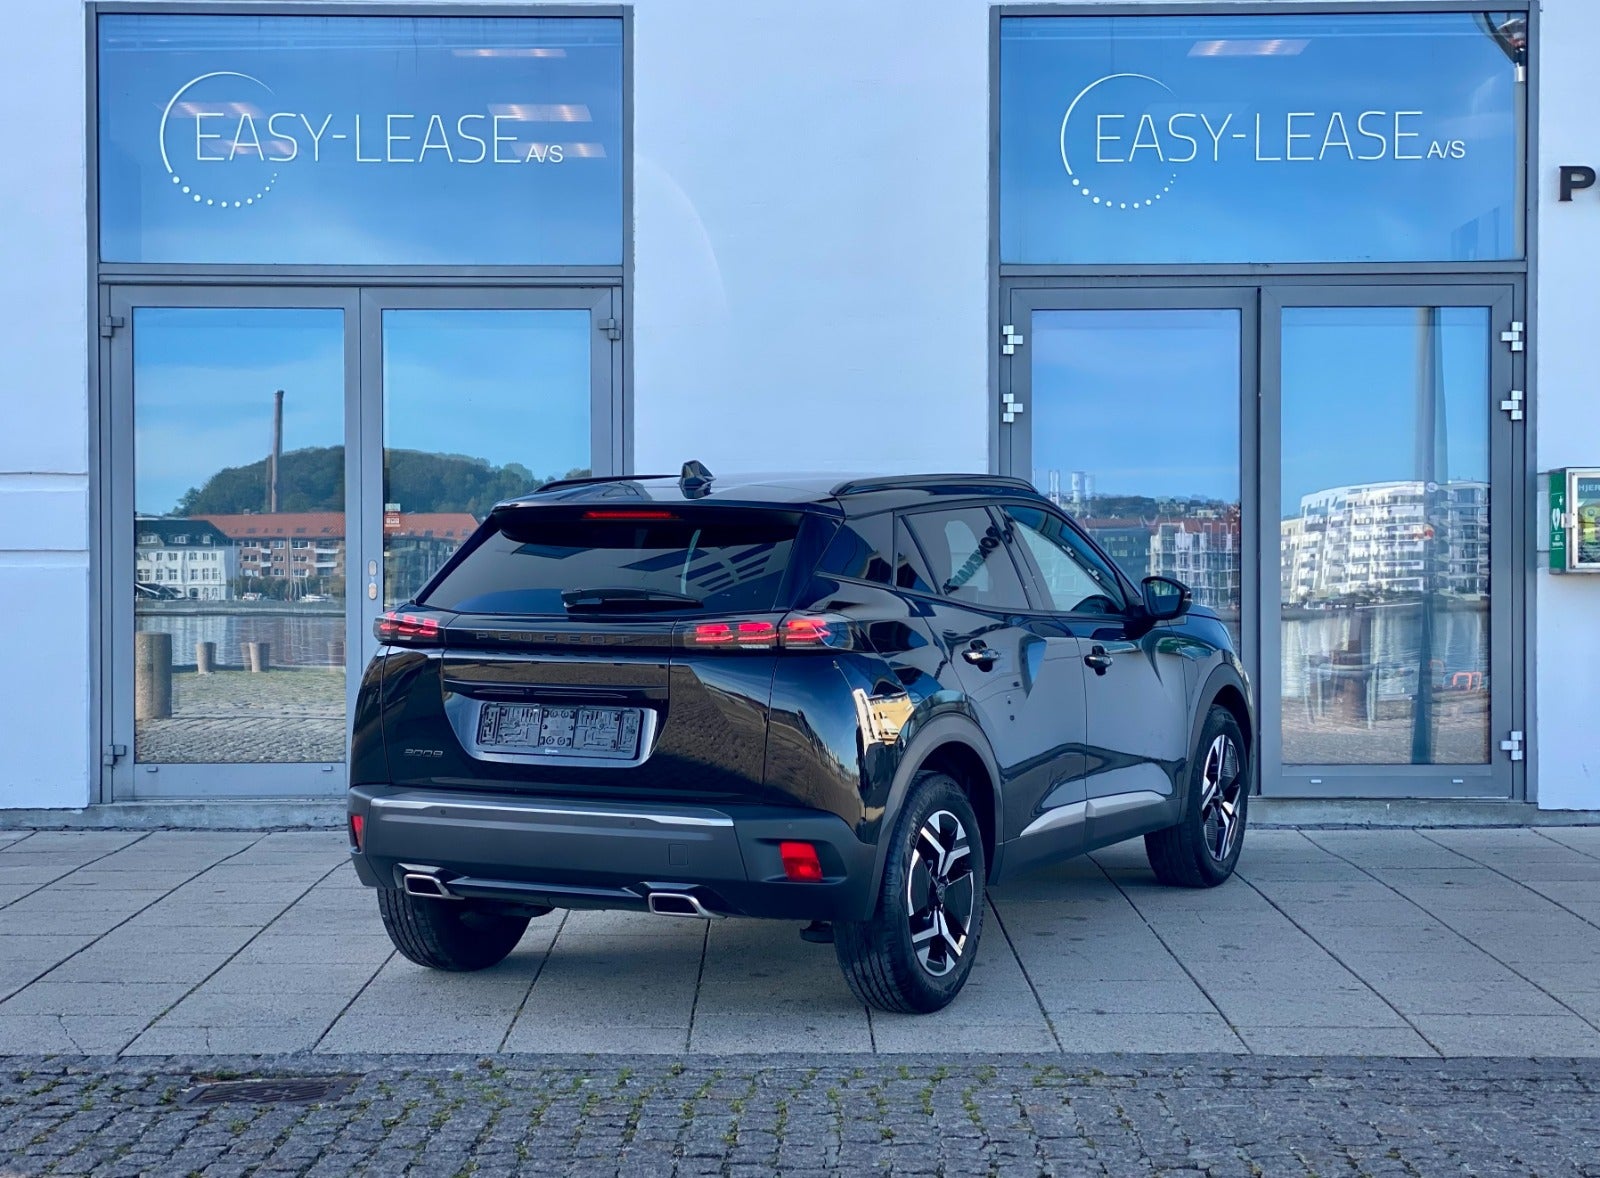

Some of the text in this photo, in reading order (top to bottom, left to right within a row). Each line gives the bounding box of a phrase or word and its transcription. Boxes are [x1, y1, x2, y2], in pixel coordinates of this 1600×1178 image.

[196, 112, 564, 163] EASY-LEASE A/S
[1096, 111, 1466, 162] EASY-LEASE A/S
[475, 631, 631, 645] PEUGEOT
